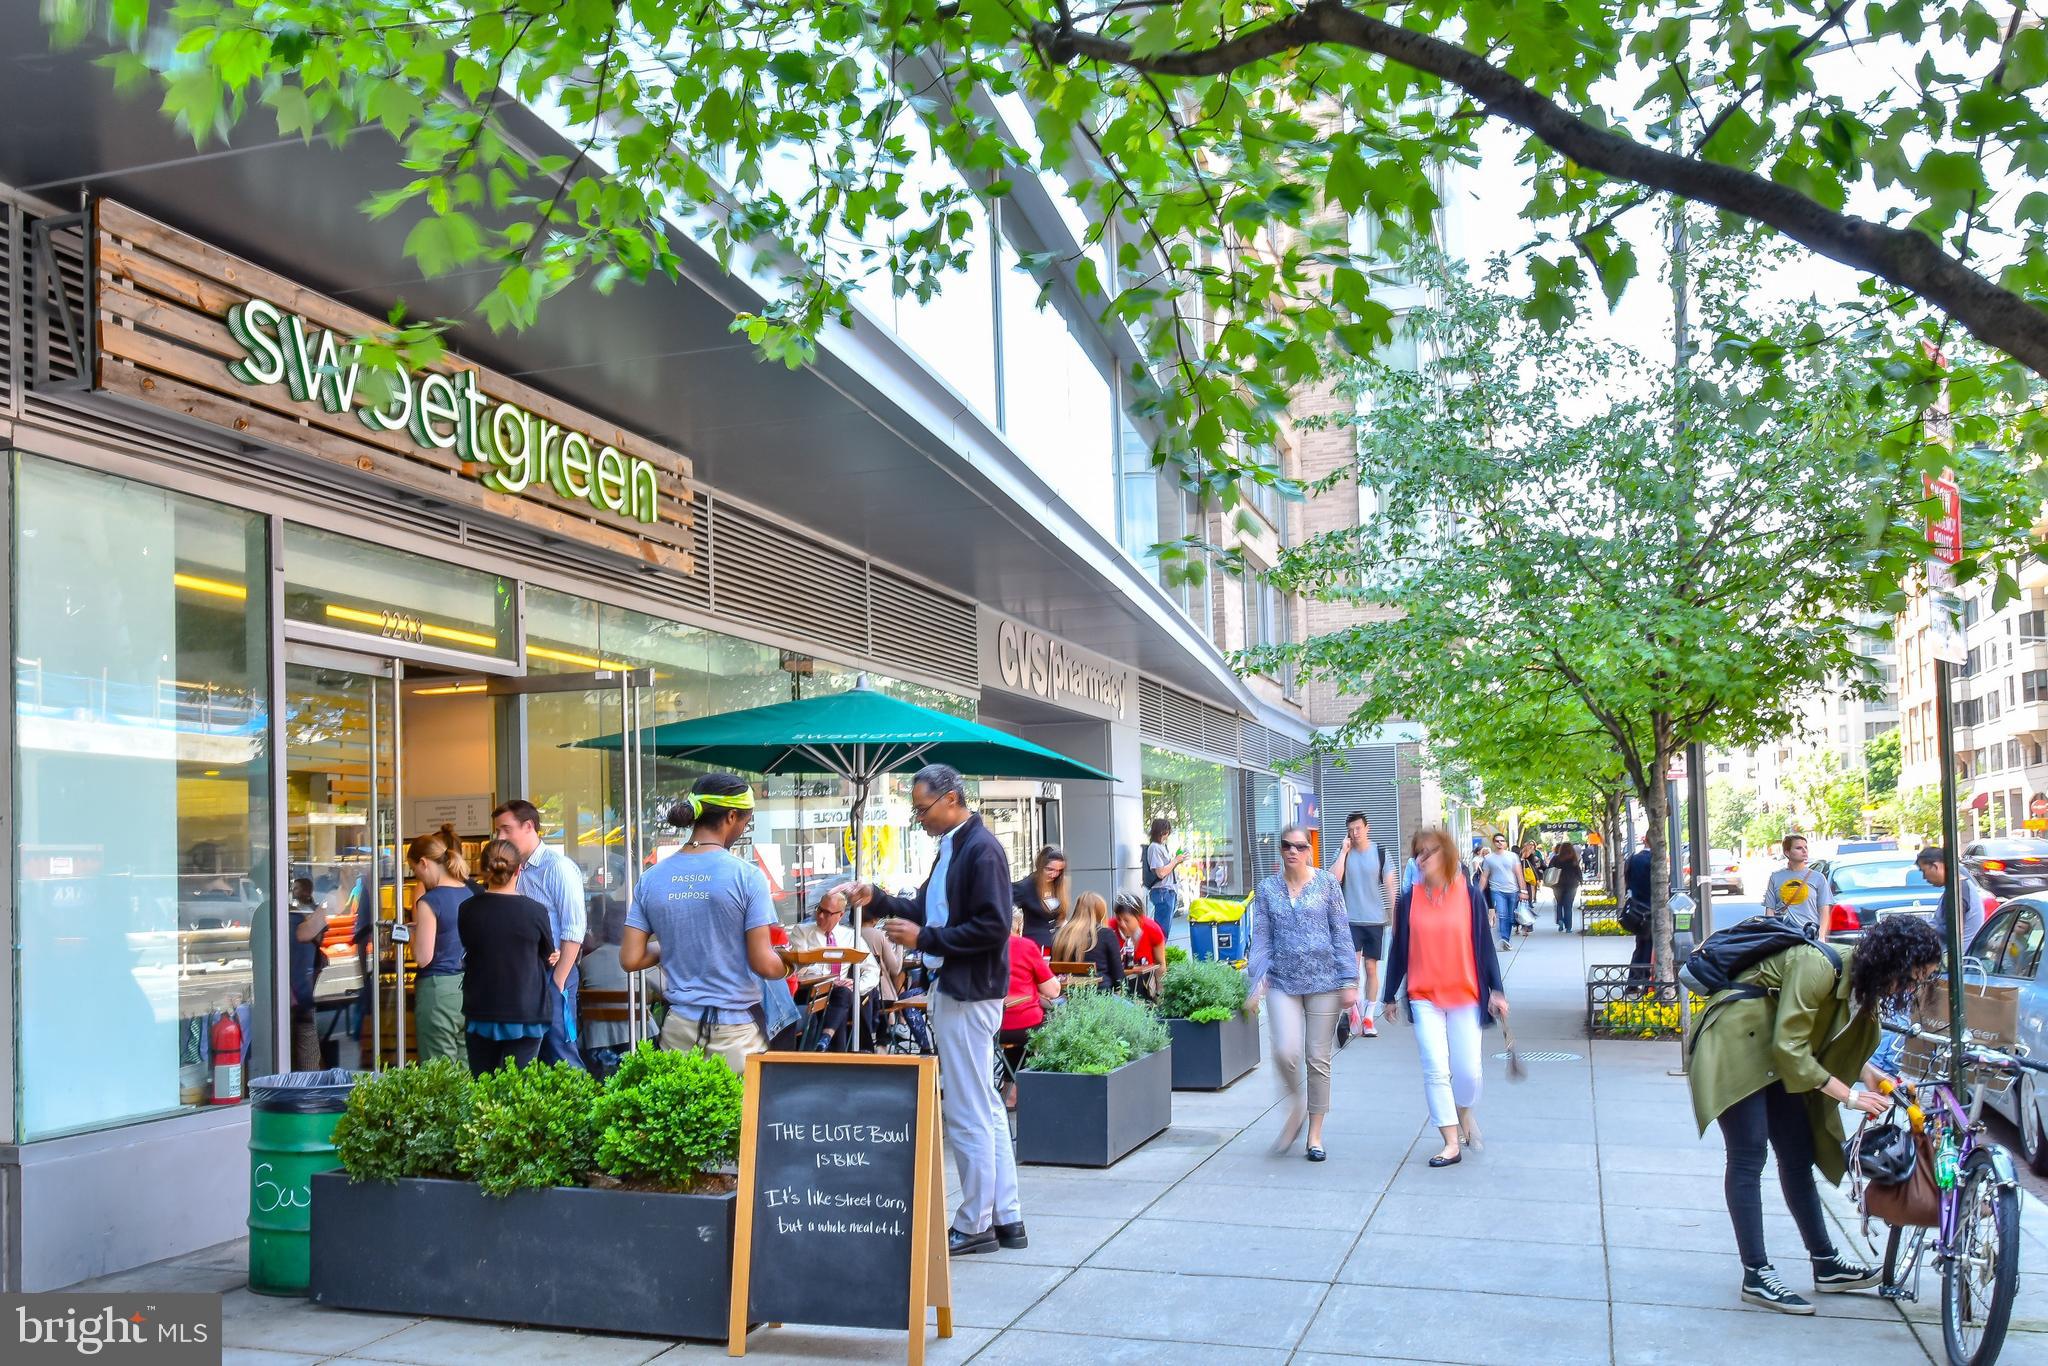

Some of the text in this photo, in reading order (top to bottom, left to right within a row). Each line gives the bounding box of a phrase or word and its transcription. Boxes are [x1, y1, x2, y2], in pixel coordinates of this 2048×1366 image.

[380, 609, 423, 644] 2238
[791, 731, 944, 740] sweetgreen
[671, 874, 712, 883] PASSION
[668, 891, 710, 900] PURPOSE
[768, 1122, 909, 1143] THE ELOTE Bowl
[816, 1152, 870, 1168] IS BACK
[764, 1185, 801, 1207] It's
[807, 1188, 832, 1206] like
[777, 1215, 803, 1234] but
[808, 1221, 815, 1232] a
[818, 1220, 847, 1233] whole
[850, 1221, 873, 1234] meal
[875, 1223, 887, 1234] of
